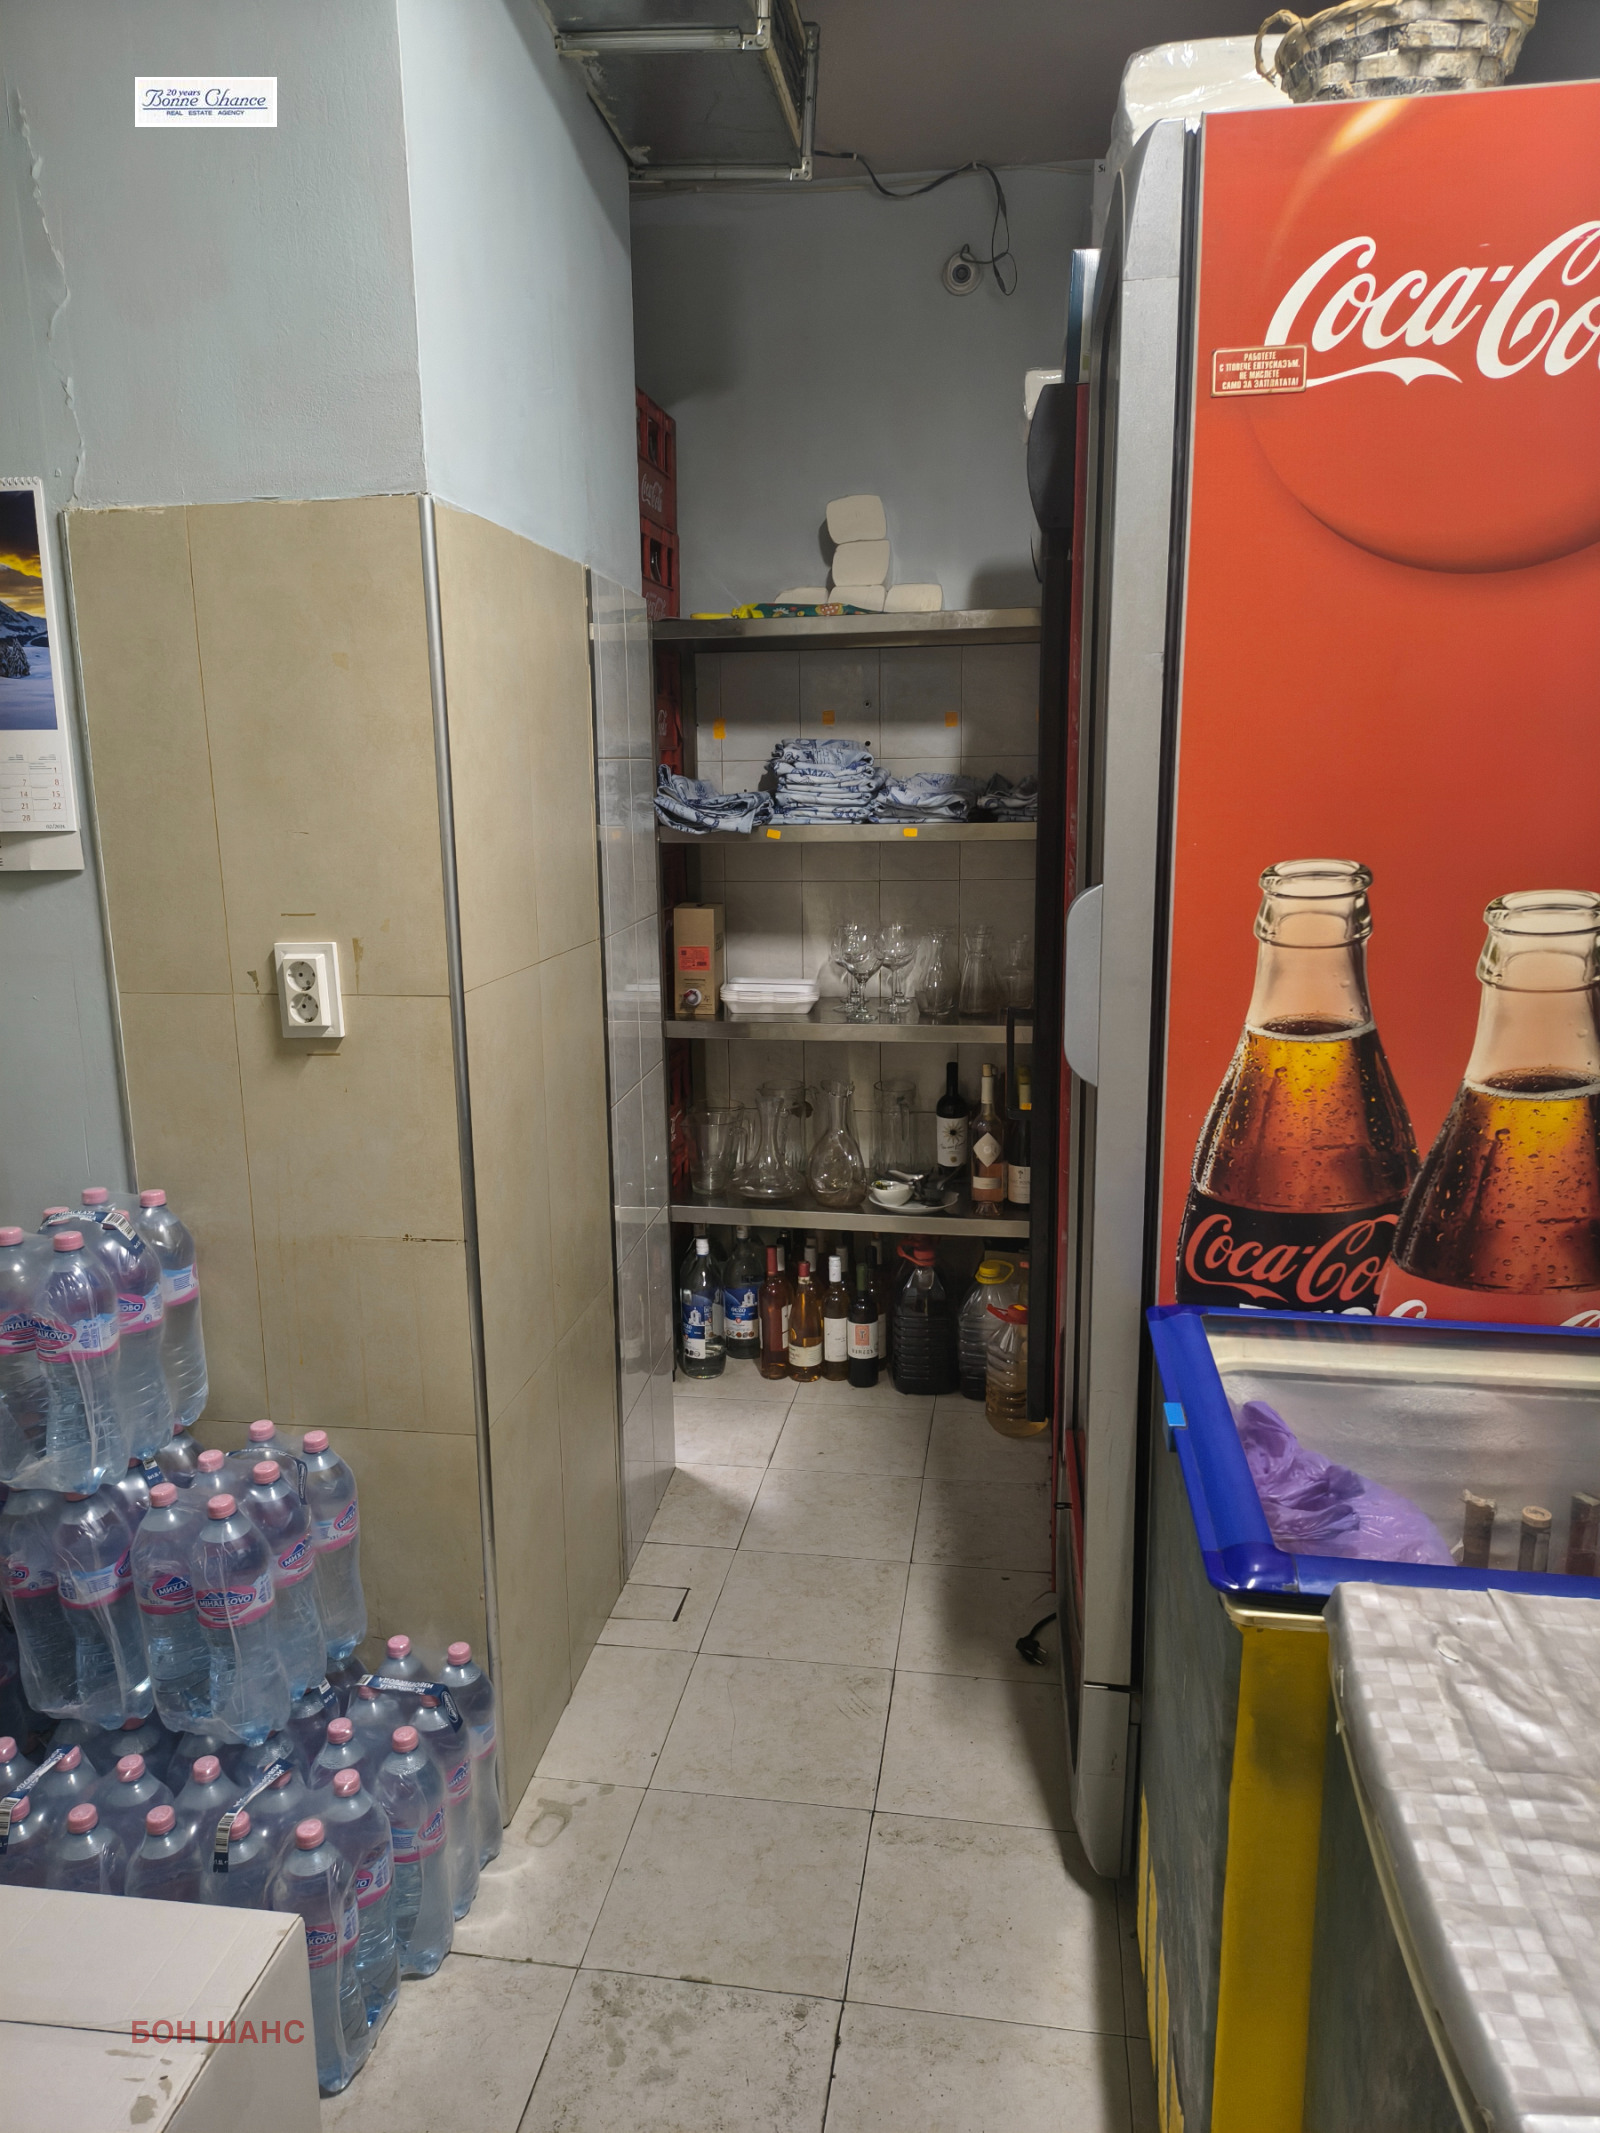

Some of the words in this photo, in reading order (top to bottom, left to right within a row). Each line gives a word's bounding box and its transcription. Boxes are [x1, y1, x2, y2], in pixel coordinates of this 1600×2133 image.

[1264, 220, 1600, 387] Coca-Co
[1244, 352, 1277, 361] РАБОТЕТЕ
[1219, 363, 1224, 372] С
[1225, 361, 1252, 372] ПОВЕЧЕ
[1239, 371, 1247, 380] НЕ
[1249, 369, 1280, 379] МИСЛЕТЕ
[1222, 380, 1242, 390] САМО
[1243, 379, 1252, 389] ЗА
[51, 790, 61, 798] 15
[20, 802, 29, 810] 21
[52, 802, 62, 810] 22
[122, 1303, 143, 1313] ОВО
[37, 1329, 70, 1341] ALKOVO
[158, 1580, 192, 1596] МИХАЛ
[307, 1933, 337, 1946] KOVO
